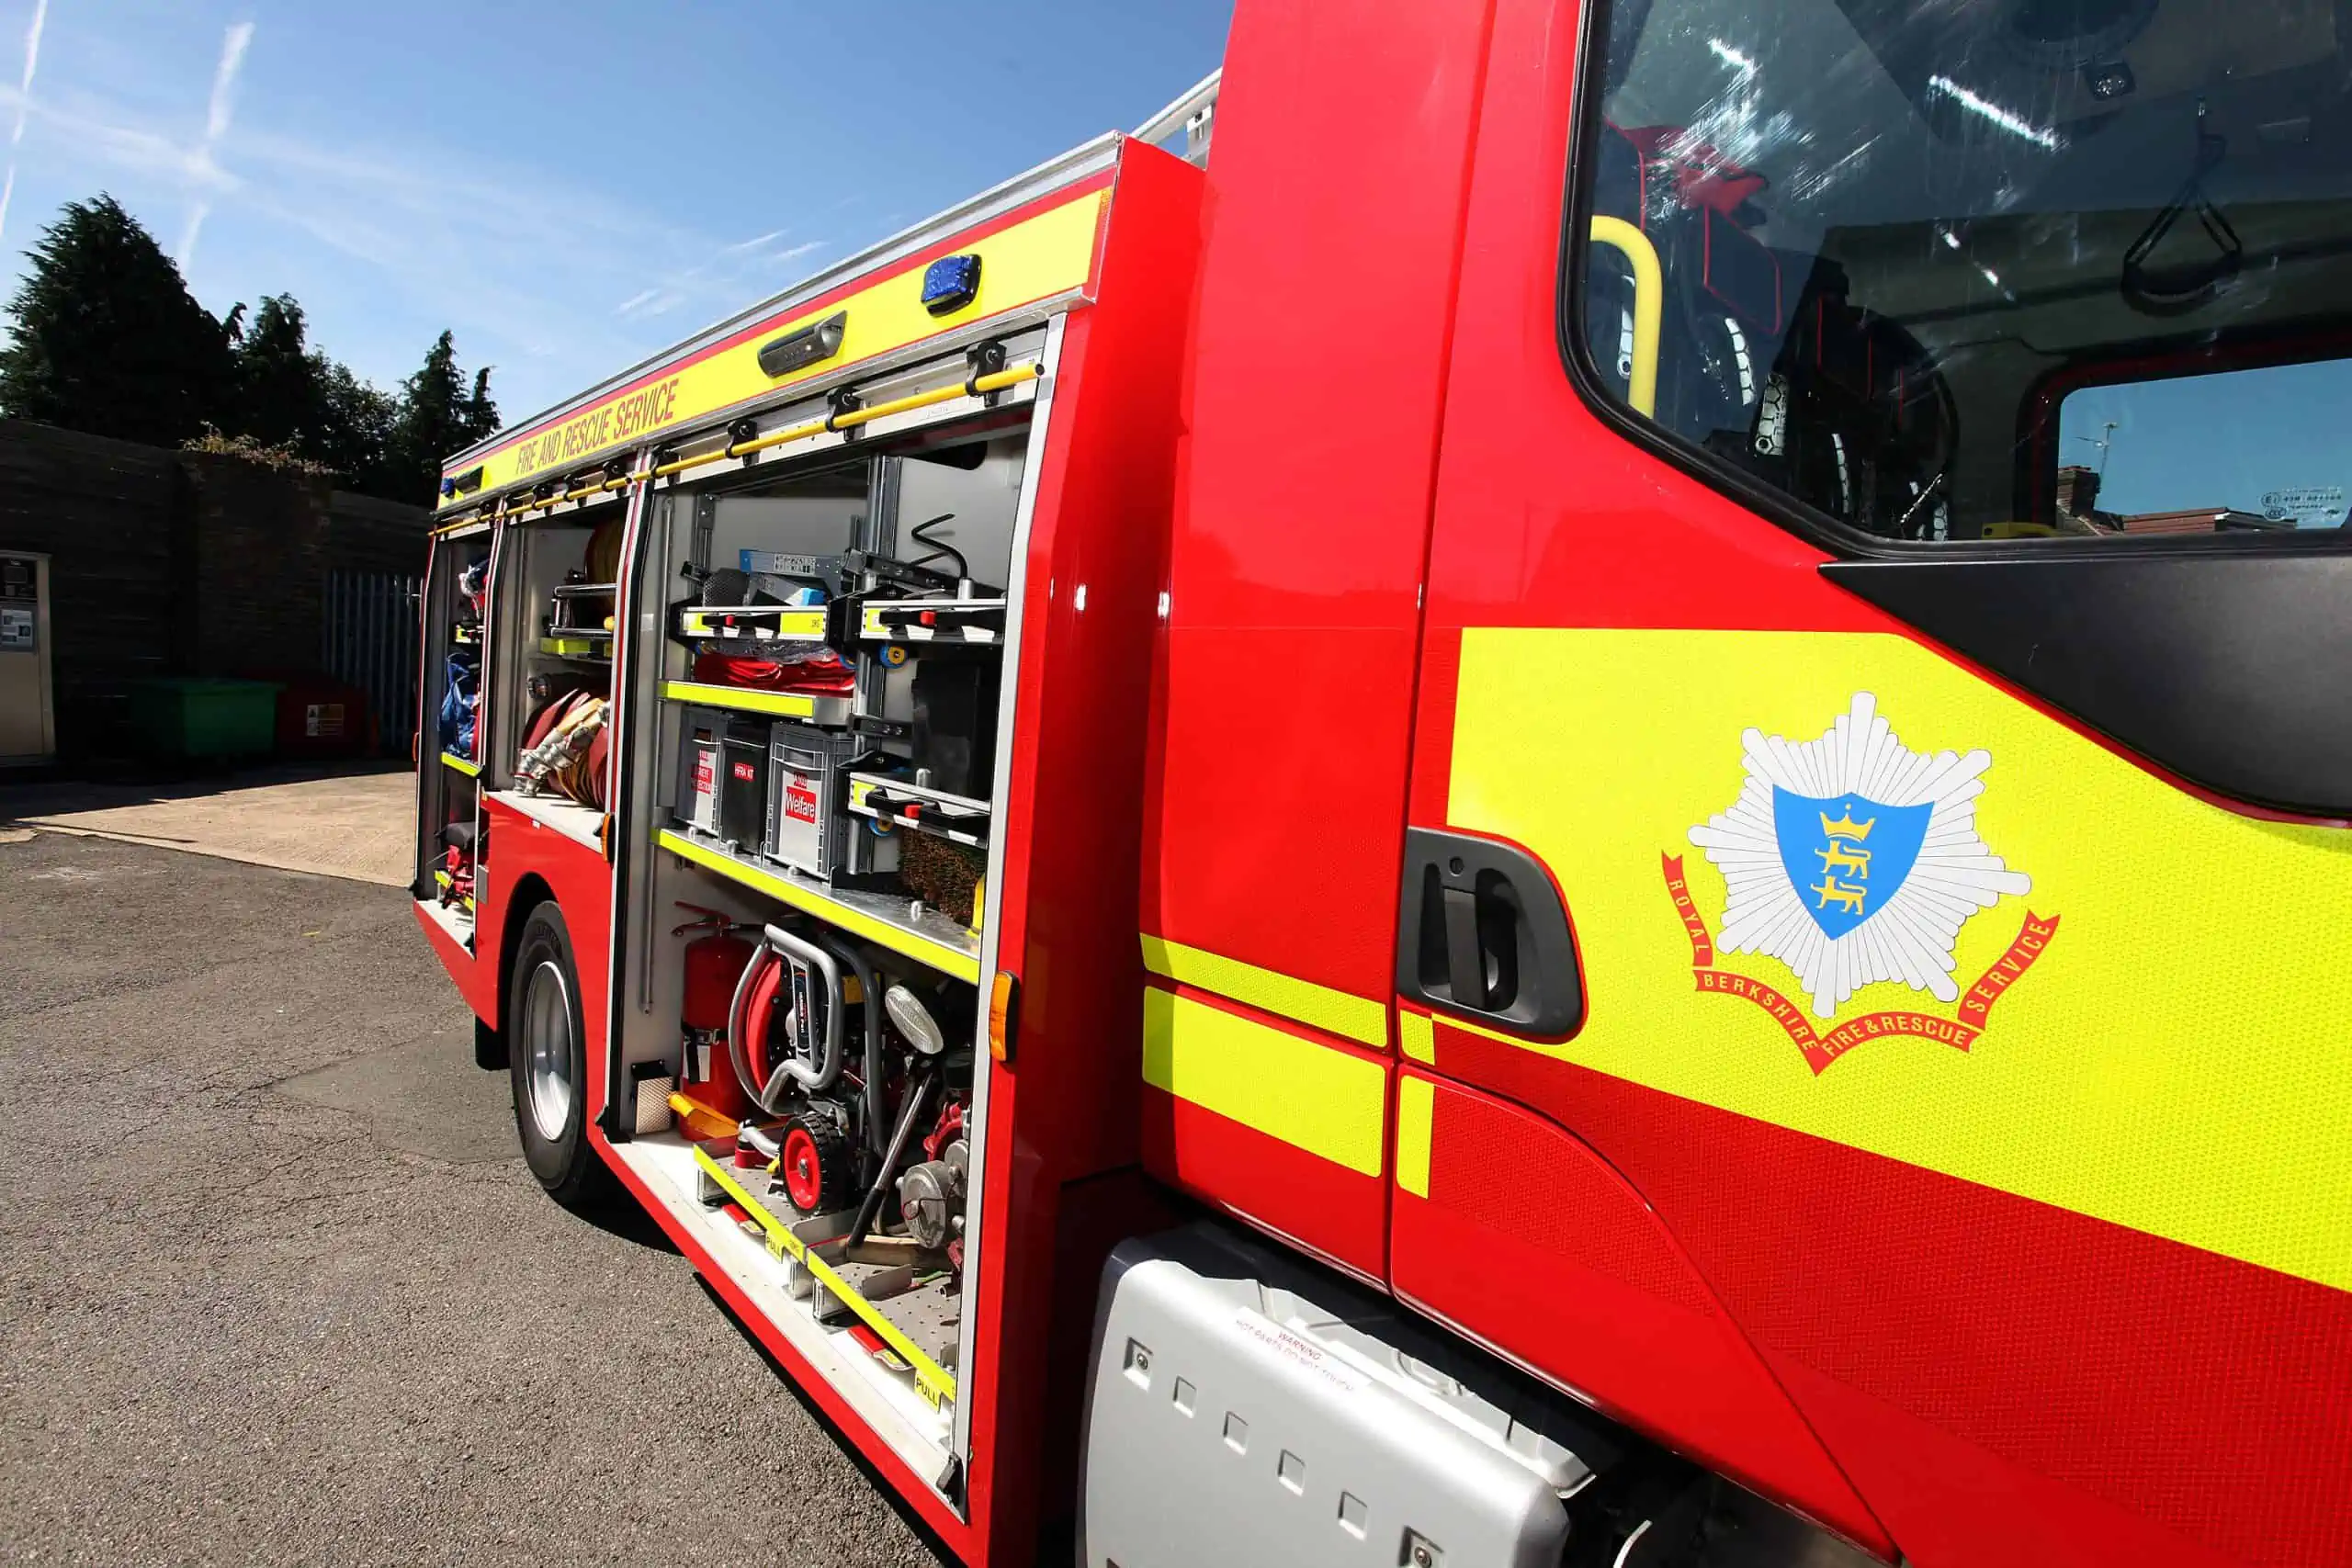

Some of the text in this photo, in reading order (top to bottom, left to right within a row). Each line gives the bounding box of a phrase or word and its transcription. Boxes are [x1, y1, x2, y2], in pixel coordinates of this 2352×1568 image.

[516, 378, 679, 475] FIRE AND RESCUE SERVICE
[786, 793, 815, 818] Welfare
[1668, 879, 1711, 954] ROYAL
[1965, 921, 2051, 1013] SERVICE
[1703, 974, 1819, 1054] BERKSHIRE
[1278, 1332, 1321, 1360] WARNING
[916, 1377, 937, 1406] PULL
